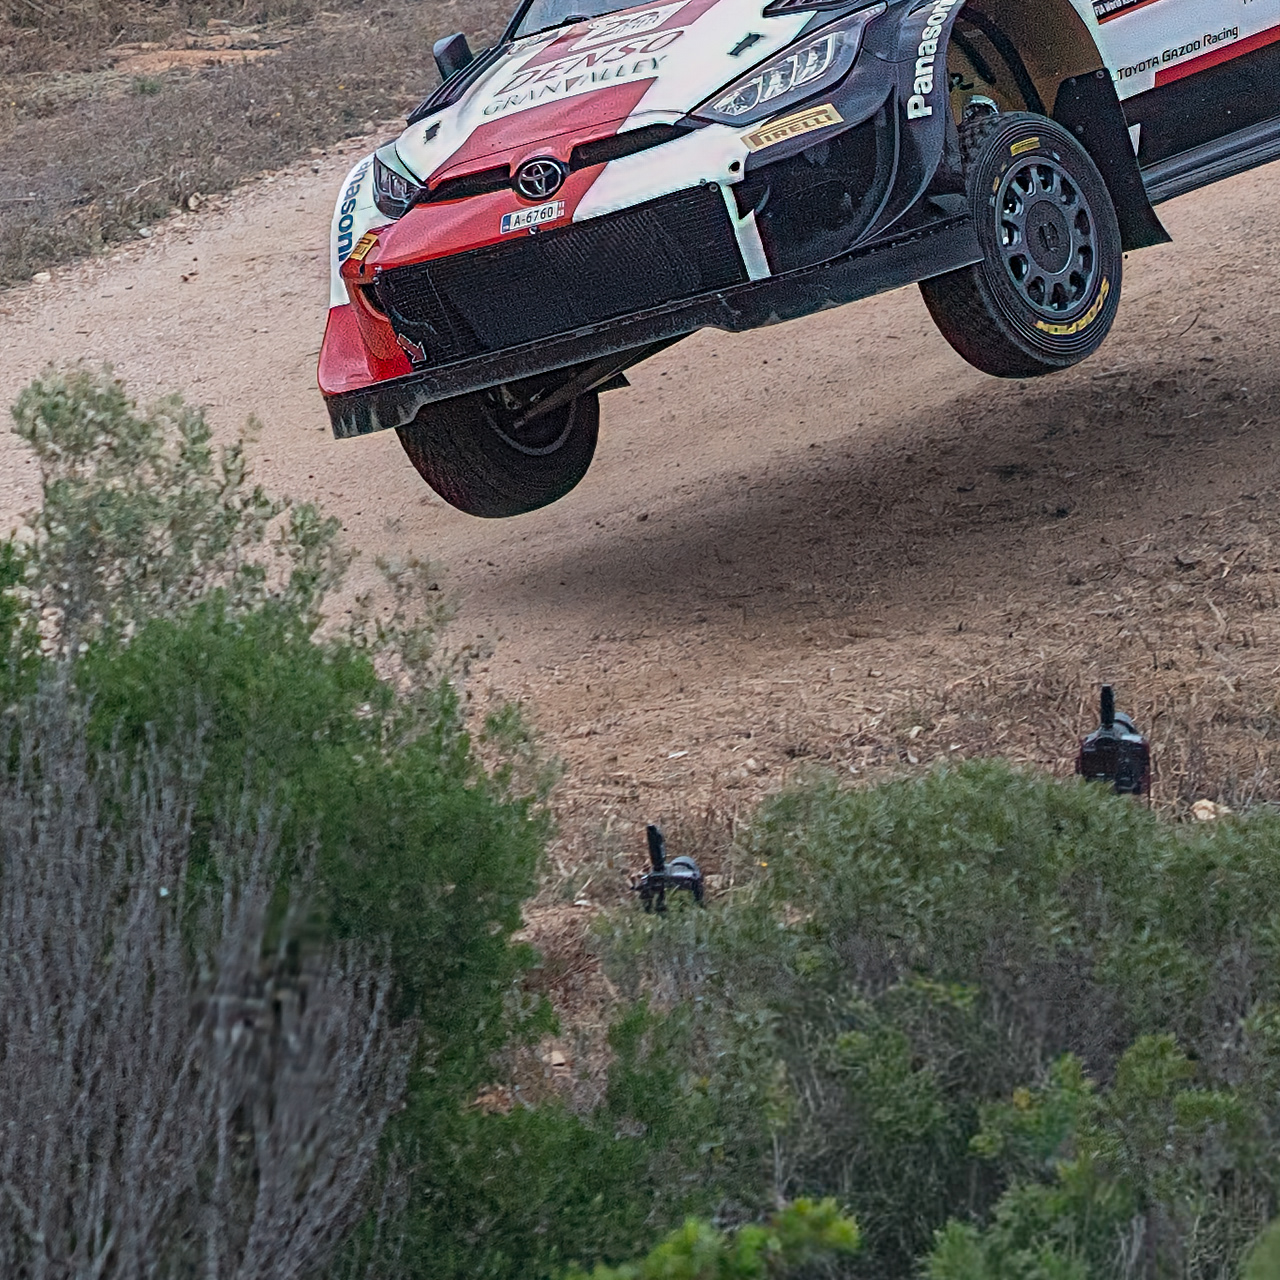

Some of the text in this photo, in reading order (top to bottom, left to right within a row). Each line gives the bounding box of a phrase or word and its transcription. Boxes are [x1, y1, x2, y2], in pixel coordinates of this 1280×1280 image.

[1093, 4, 1107, 17] FIA
[493, 30, 685, 97] DENSO
[1117, 25, 1239, 80] TOYOTA GAZOO Racing
[748, 108, 835, 148] PIRELLI
[514, 206, 554, 227] A-6760
